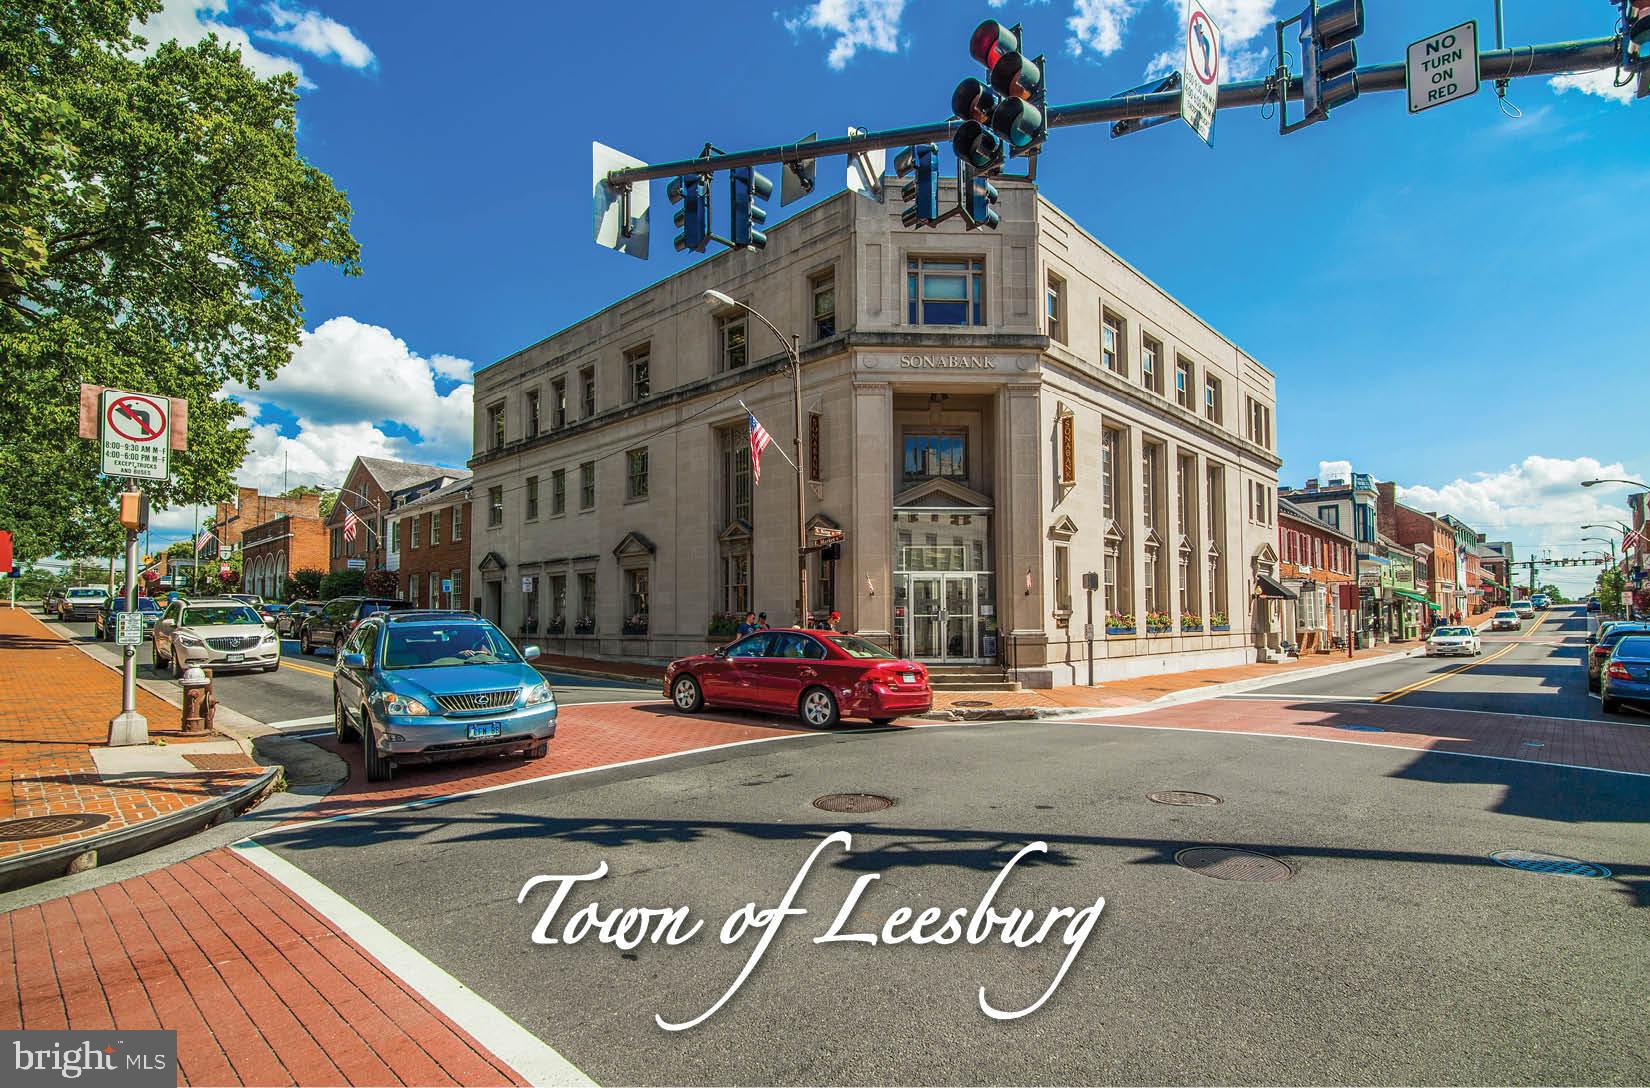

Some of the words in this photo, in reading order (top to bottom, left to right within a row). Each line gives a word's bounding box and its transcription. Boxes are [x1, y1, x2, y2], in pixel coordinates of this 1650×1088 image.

[1426, 35, 1456, 56] NO
[1421, 49, 1462, 72] TURN
[1431, 68, 1453, 84] ON
[1428, 83, 1457, 102] RED
[901, 354, 995, 369] SONABANK
[141, 445, 151, 453] AM
[1064, 419, 1072, 481] SONABANK
[114, 460, 135, 468] EXCEPT
[137, 462, 157, 470] TRUCKS
[141, 454, 151, 462] PM
